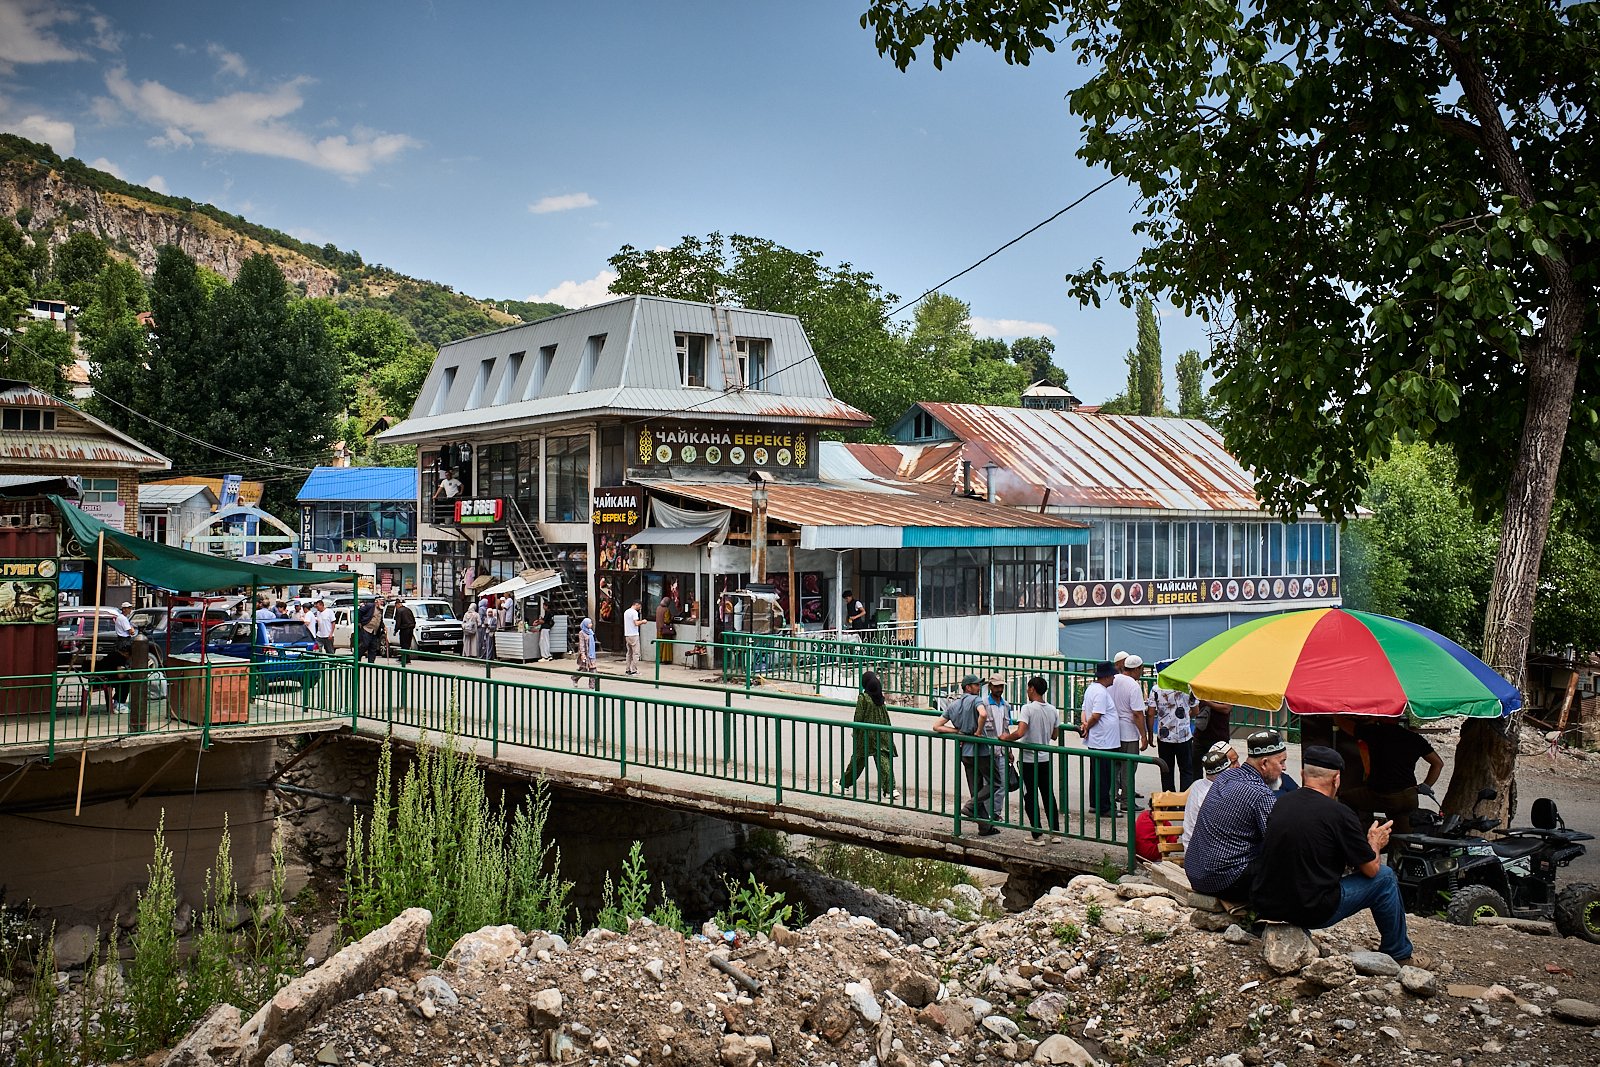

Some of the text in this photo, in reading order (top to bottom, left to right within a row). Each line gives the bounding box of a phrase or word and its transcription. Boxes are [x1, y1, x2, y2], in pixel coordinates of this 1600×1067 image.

[656, 430, 792, 447] ЧАЙКАНА БЕРЕКЕ
[593, 493, 637, 507] ЧАЙКАНА
[602, 513, 626, 522] БЕРЕКЕ
[303, 506, 311, 550] ТУРАН
[317, 554, 362, 562] ТУРАН
[3, 563, 37, 576] ГУШТ
[1156, 581, 1197, 591] ЧАЙКАНА
[1157, 593, 1197, 604] БЕРЕКЕ
